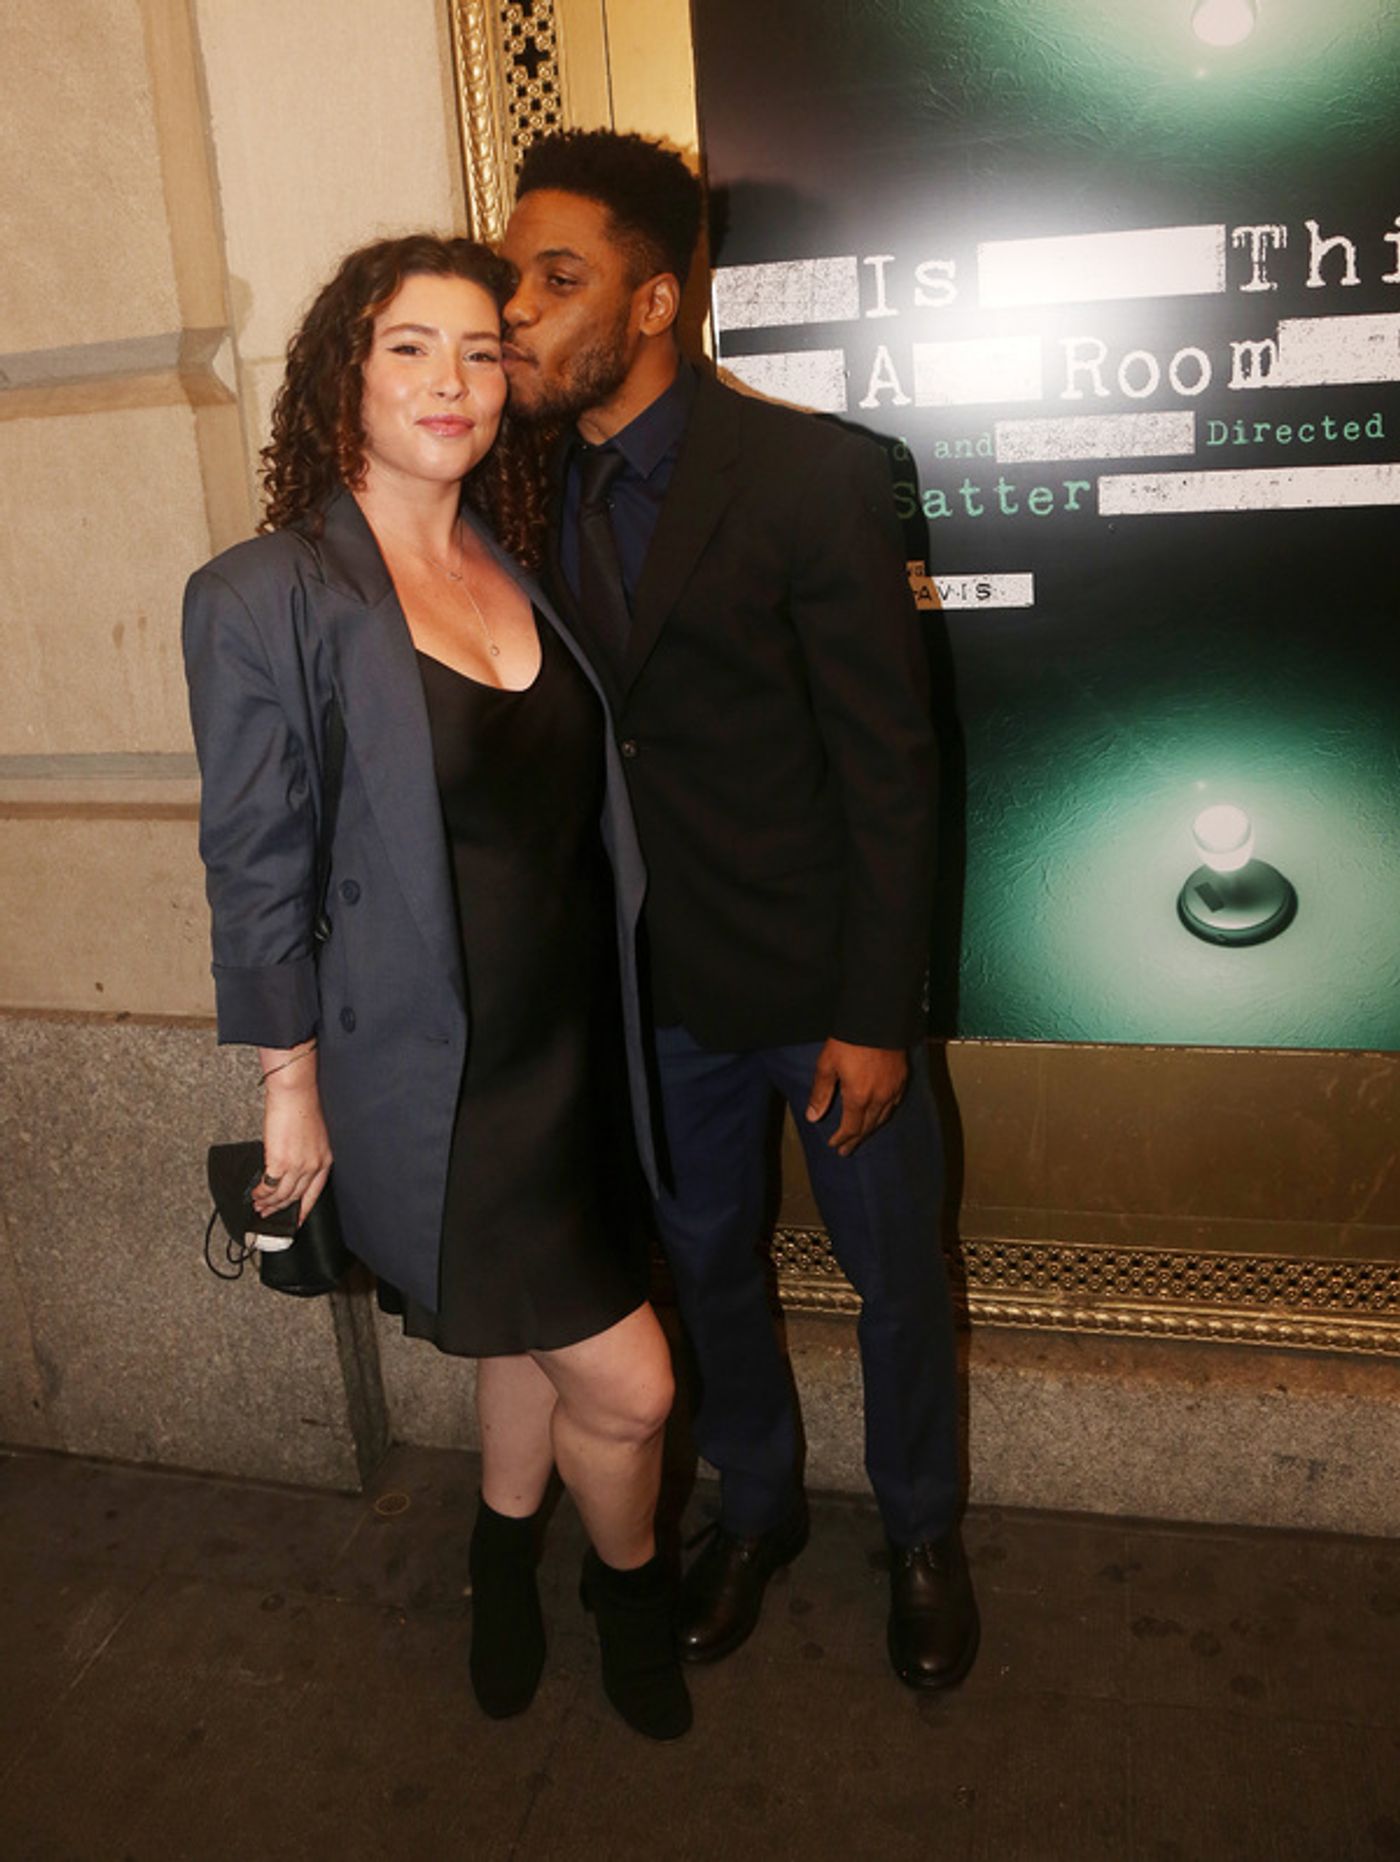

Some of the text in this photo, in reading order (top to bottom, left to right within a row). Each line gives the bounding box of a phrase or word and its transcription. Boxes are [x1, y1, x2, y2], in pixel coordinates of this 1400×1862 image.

[862, 254, 958, 319] Is
[858, 336, 1279, 408] A Room
[934, 432, 996, 460] and
[1206, 412, 1385, 446] Directed
[892, 475, 1091, 520] Satter
[914, 582, 992, 601] AVIS
